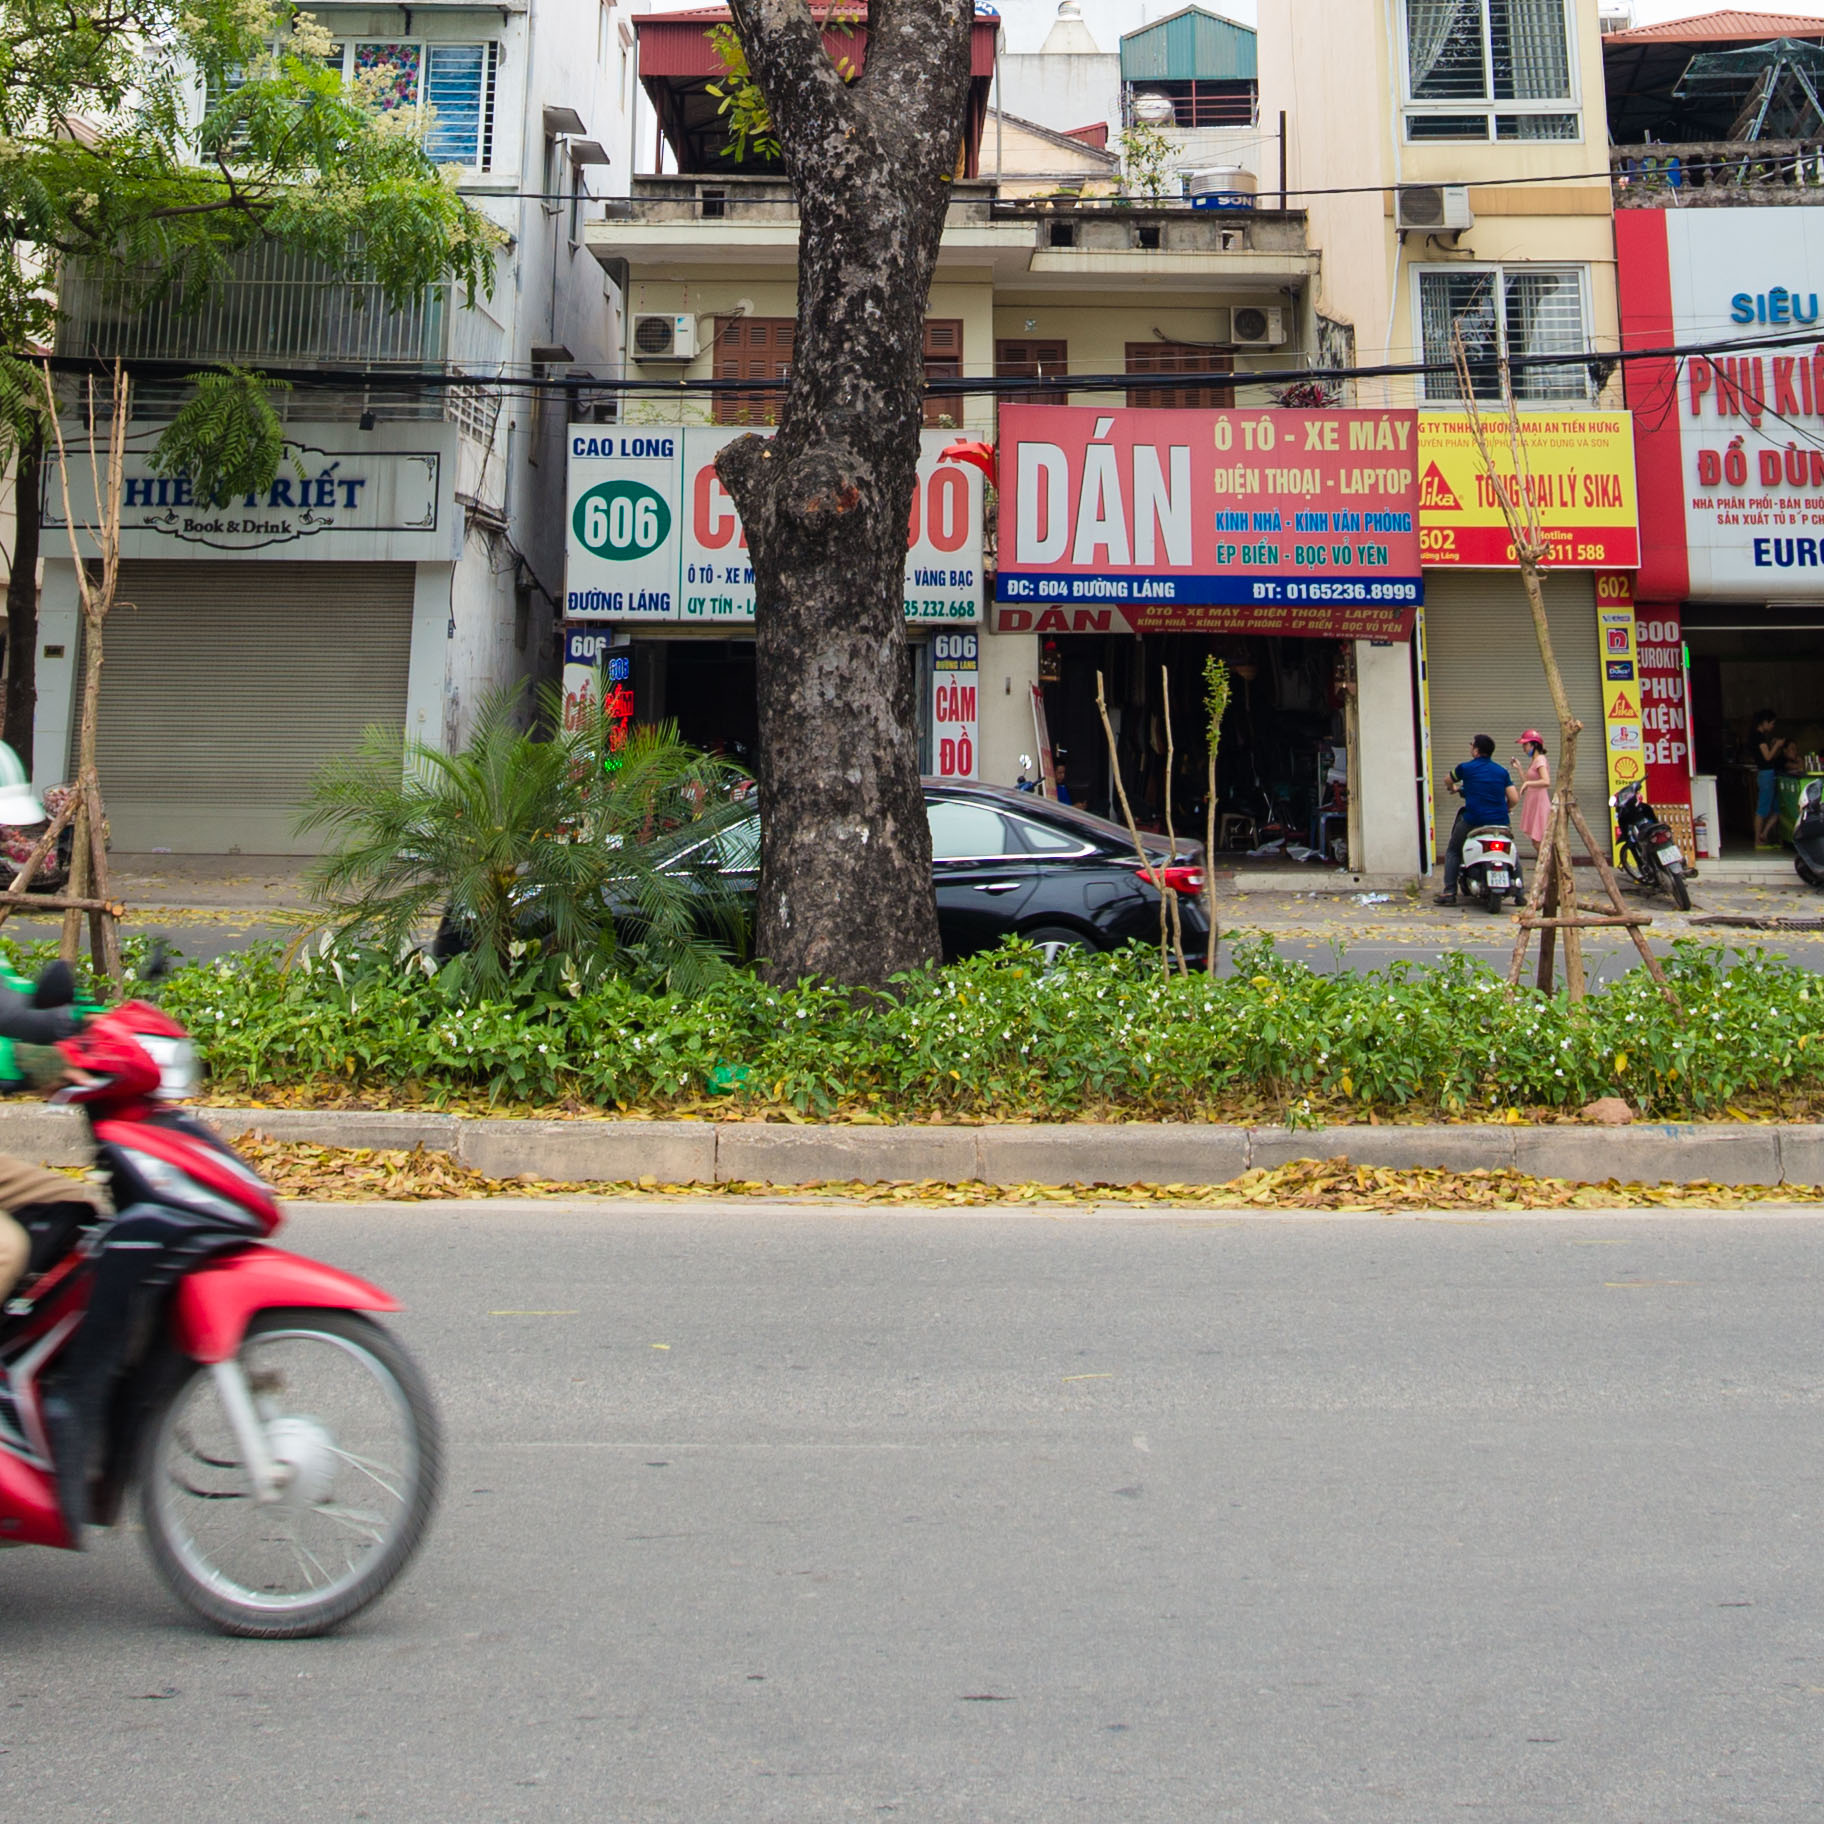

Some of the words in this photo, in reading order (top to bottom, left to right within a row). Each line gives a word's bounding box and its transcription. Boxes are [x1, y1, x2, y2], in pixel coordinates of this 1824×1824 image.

[1731, 286, 1818, 325] SIÊU
[1688, 356, 1765, 428] PHỤ
[1214, 416, 1232, 451] Ô
[1241, 416, 1276, 451] TÔ
[1305, 423, 1341, 451] XE
[1349, 415, 1412, 451] MÁY
[573, 437, 614, 457] CAO
[620, 438, 674, 458] LONG
[1697, 435, 1748, 487] ĐỒ
[1015, 417, 1192, 566] DÁN
[1214, 463, 1260, 500] ĐIỆN
[1264, 467, 1320, 500] THOẠI
[1340, 467, 1413, 495] LAPTOP
[1559, 466, 1577, 508] LÝ
[1584, 474, 1624, 508] SIKA
[184, 519, 224, 534] Book
[227, 520, 240, 533] &
[242, 519, 292, 535] Drink
[584, 496, 659, 549] 606
[1215, 508, 1249, 533] KÍNH
[1252, 509, 1282, 533] NHÀ
[1295, 508, 1329, 533] KÍNH
[1332, 508, 1361, 533] VĂN
[1363, 508, 1413, 533] PHÒNG
[1419, 529, 1456, 550] 602
[1241, 537, 1280, 565] BIỂN
[1294, 544, 1327, 570] BỌC
[1331, 537, 1353, 565] VỎ
[1356, 541, 1389, 565] YÊN
[915, 566, 946, 586] VÀNG
[950, 569, 974, 590] BẠC
[1008, 579, 1035, 597] ĐC:
[1039, 581, 1068, 597] 604
[1072, 577, 1129, 598] ĐƯỜNG
[1132, 579, 1176, 598] LÁNG
[1253, 583, 1282, 599] ĐT:
[1287, 583, 1417, 600] 0165236.8999
[1598, 576, 1630, 598] 602
[568, 586, 623, 612] ĐƯỜNG
[628, 588, 671, 612] LÁNG
[997, 605, 1114, 632] DÁN
[1636, 620, 1680, 643] 600
[936, 634, 976, 658] 606
[1637, 647, 1681, 669] EUROKIT
[936, 673, 976, 723] CẦM
[1640, 678, 1683, 703] PHỤ
[1642, 703, 1684, 733] KIỆN
[939, 725, 973, 776] ĐỒ
[1644, 733, 1687, 764] BẾP
